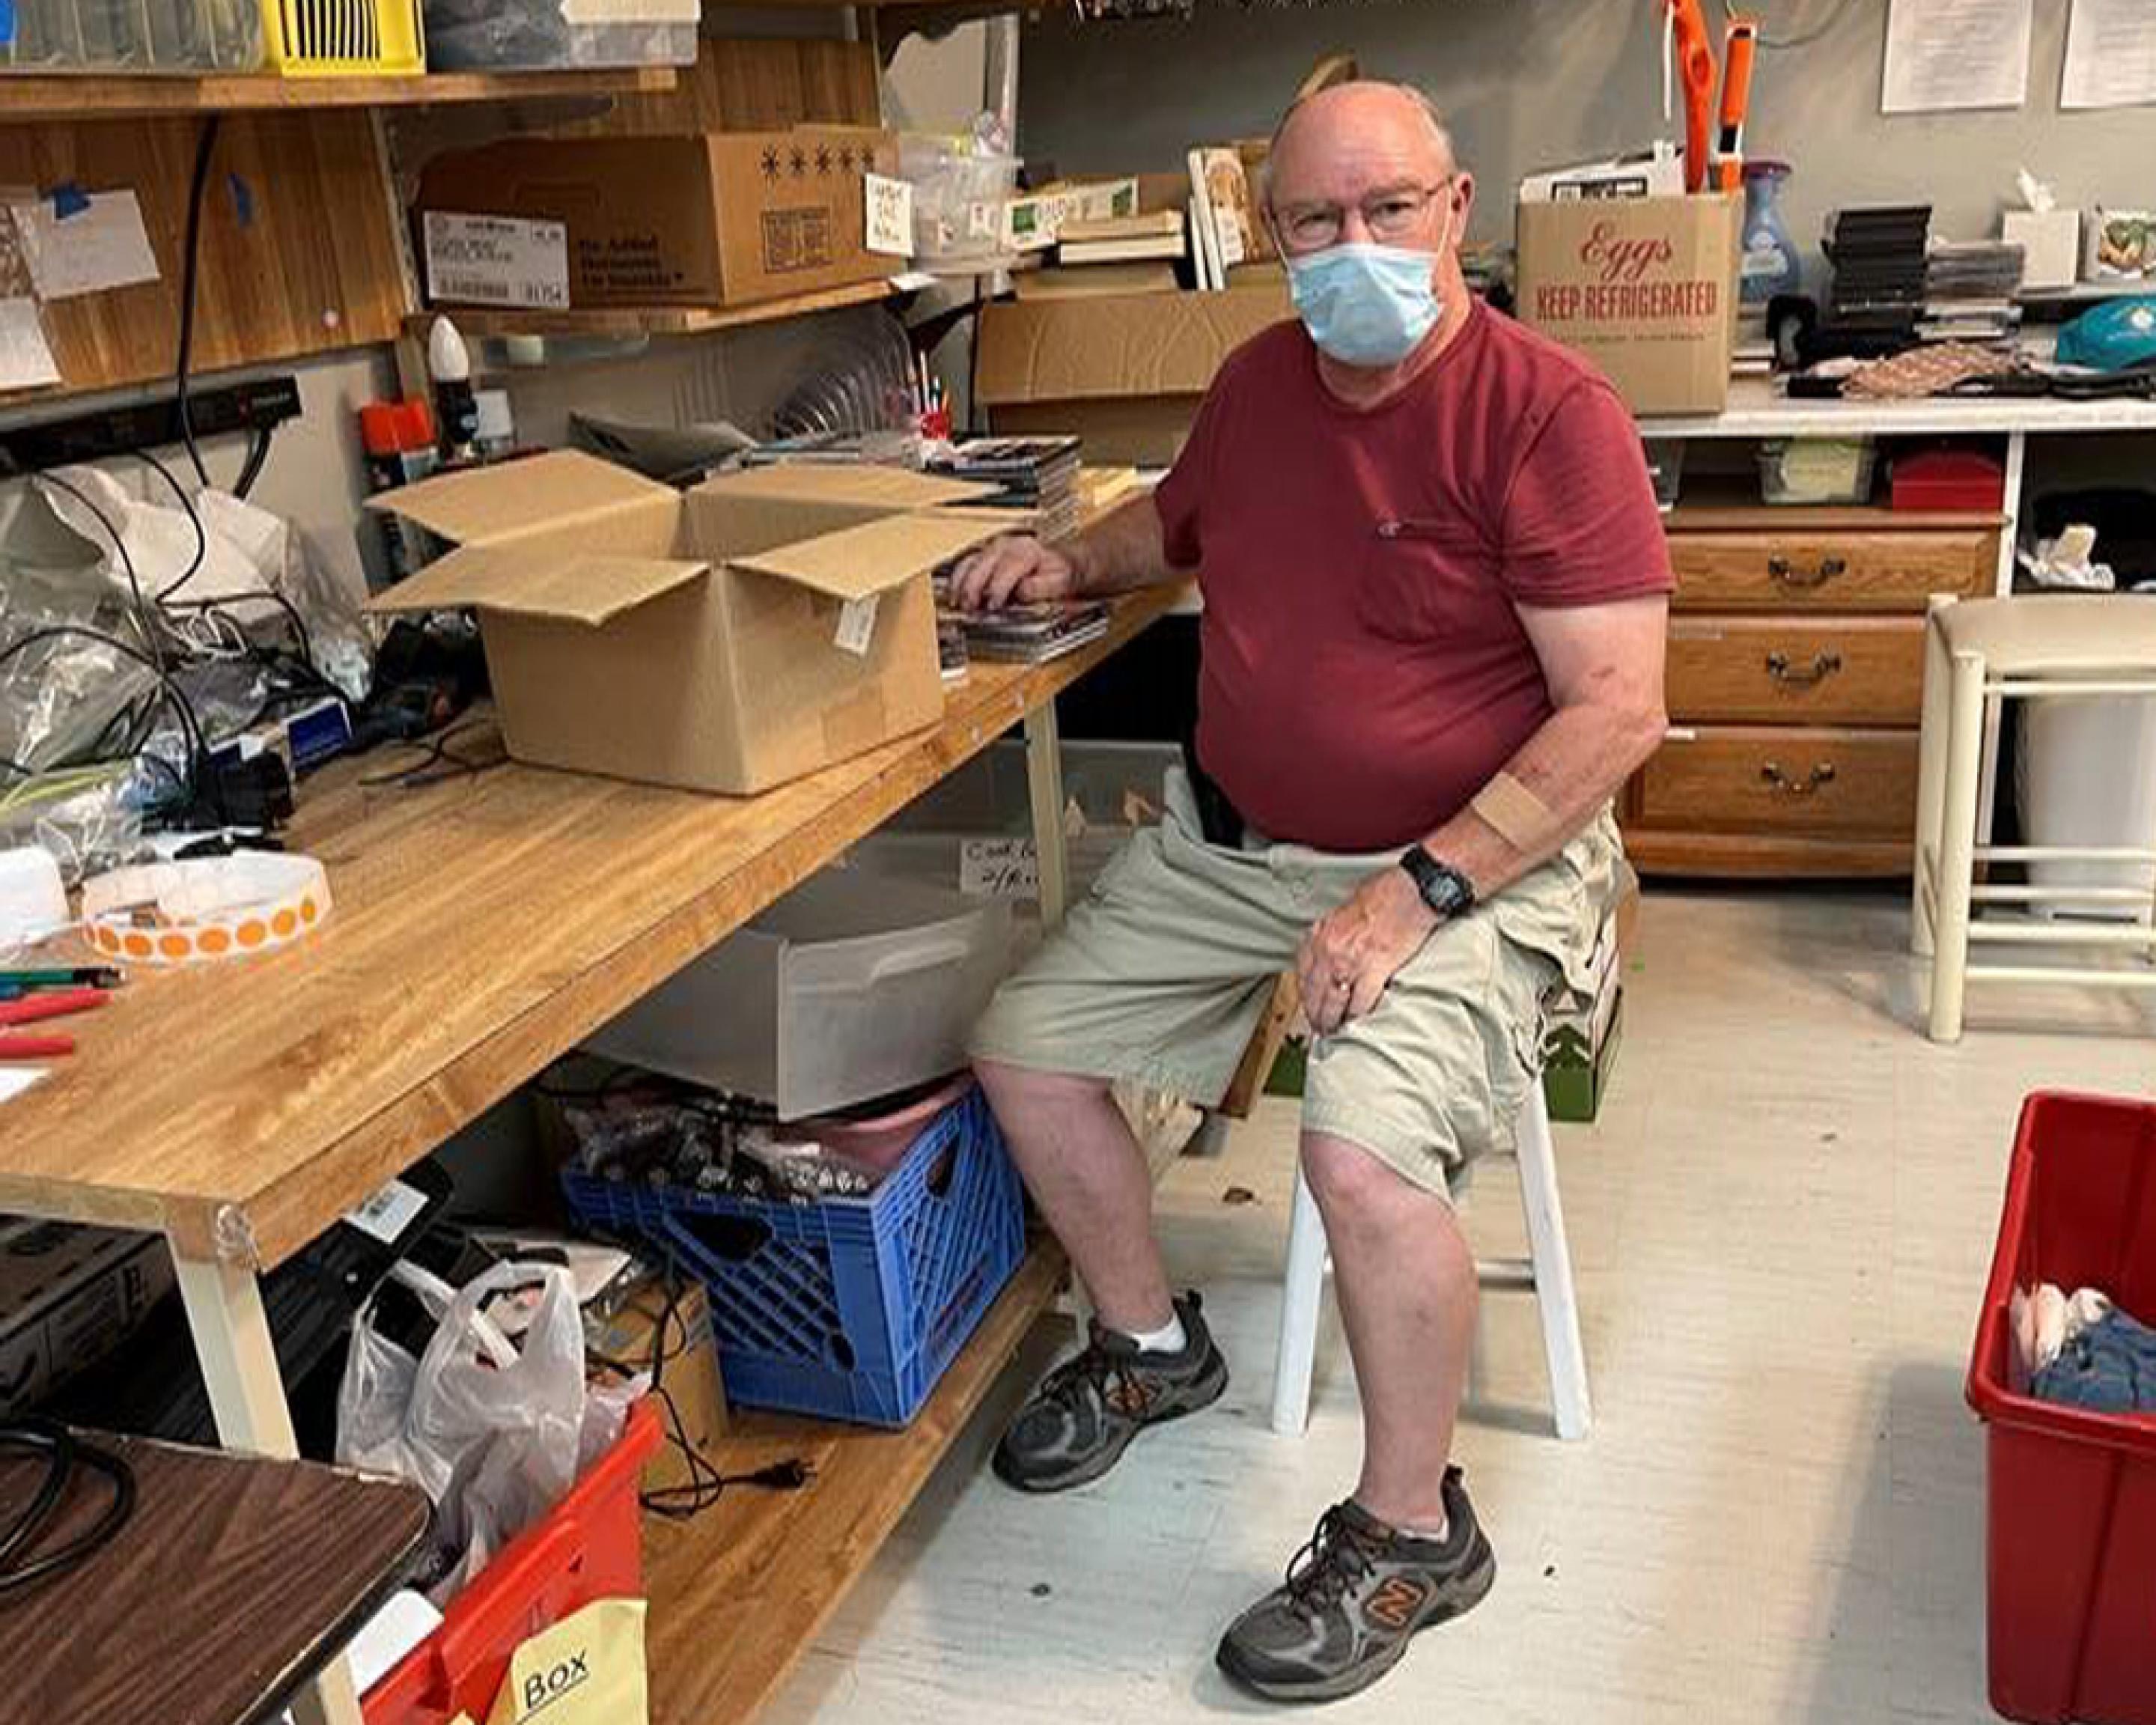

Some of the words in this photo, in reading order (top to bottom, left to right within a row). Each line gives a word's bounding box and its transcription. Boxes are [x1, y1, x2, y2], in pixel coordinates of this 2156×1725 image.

[1580, 222, 1673, 282] Eggs
[1536, 283, 1582, 321] KEEP
[1583, 279, 1717, 320] REFRIGERATED
[1366, 1578, 1422, 1626] N
